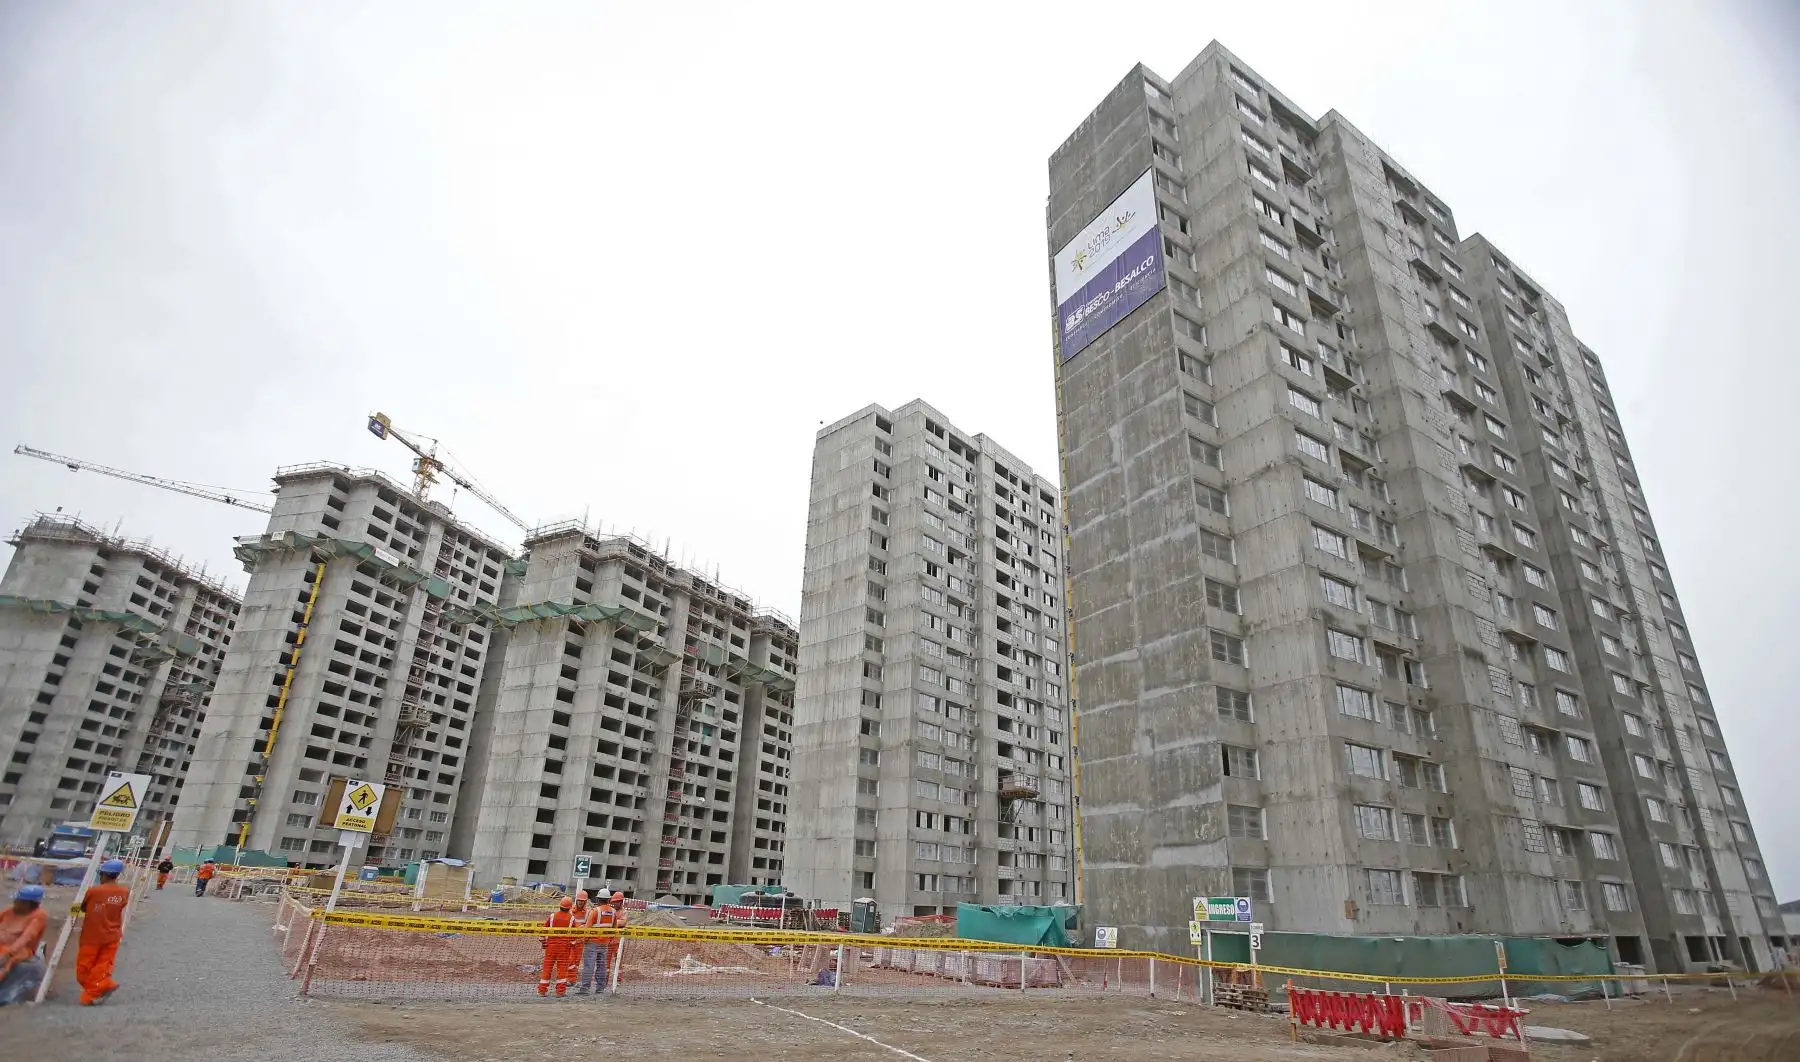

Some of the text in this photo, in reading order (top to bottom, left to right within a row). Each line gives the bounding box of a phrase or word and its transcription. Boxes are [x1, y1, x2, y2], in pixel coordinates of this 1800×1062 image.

[1088, 226, 1110, 249] Lima
[1089, 235, 1111, 258] 2019
[1085, 291, 1110, 317] BESCO
[1115, 255, 1154, 293] BESALCO
[99, 810, 131, 818] PELIGRO
[341, 821, 367, 829] PEATONAL
[1208, 903, 1235, 915] INGRESO
[1252, 935, 1260, 948] 3
